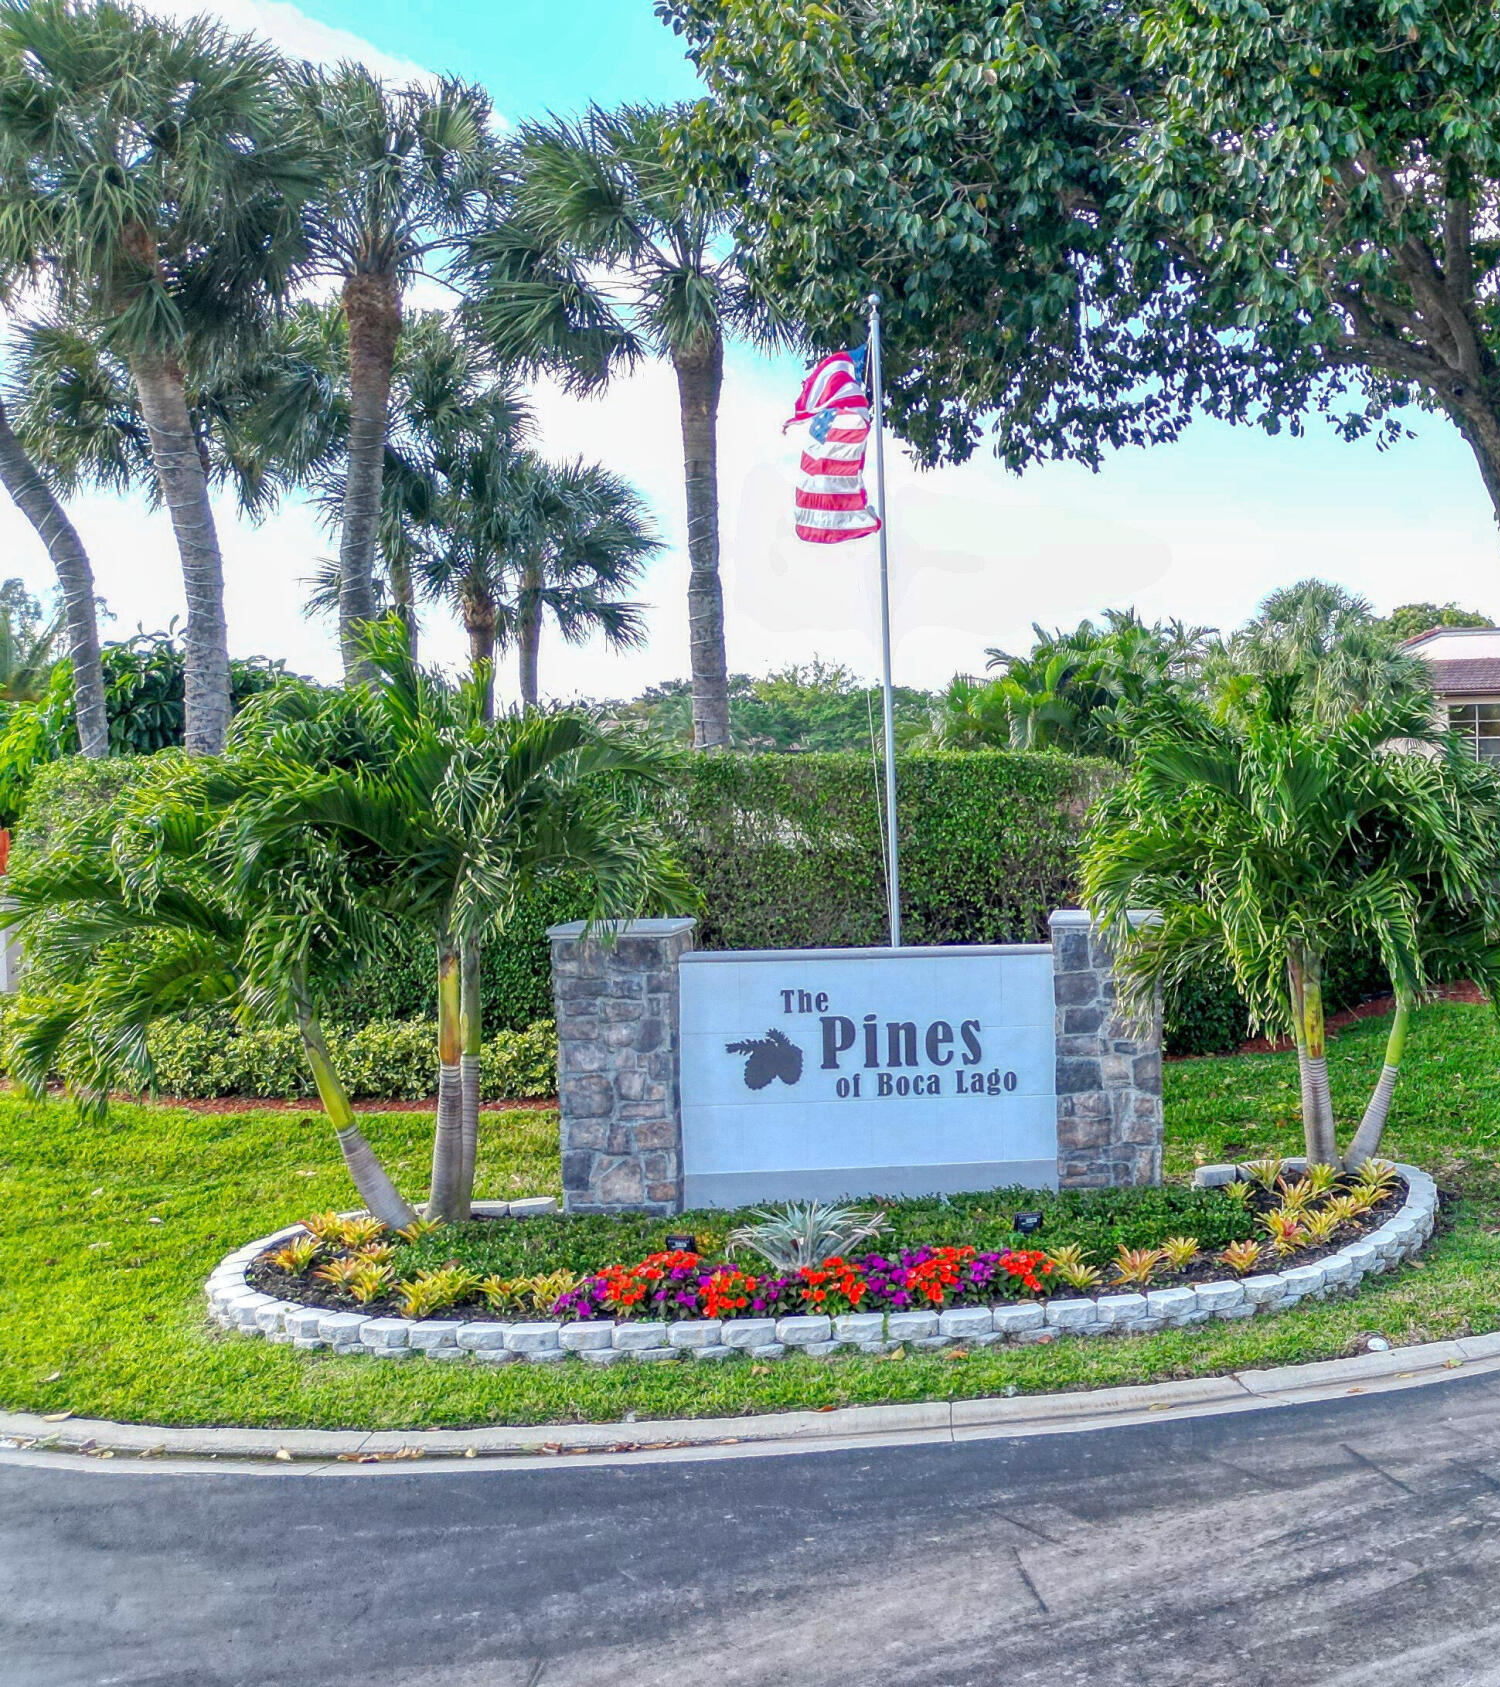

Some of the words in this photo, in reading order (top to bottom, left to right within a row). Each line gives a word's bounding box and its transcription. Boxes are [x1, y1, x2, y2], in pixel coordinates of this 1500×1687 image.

[780, 989, 829, 1014] The
[819, 1013, 982, 1070] Pines
[836, 1073, 861, 1098] of
[877, 1072, 941, 1097] Boca
[956, 1068, 1017, 1095] Lago
